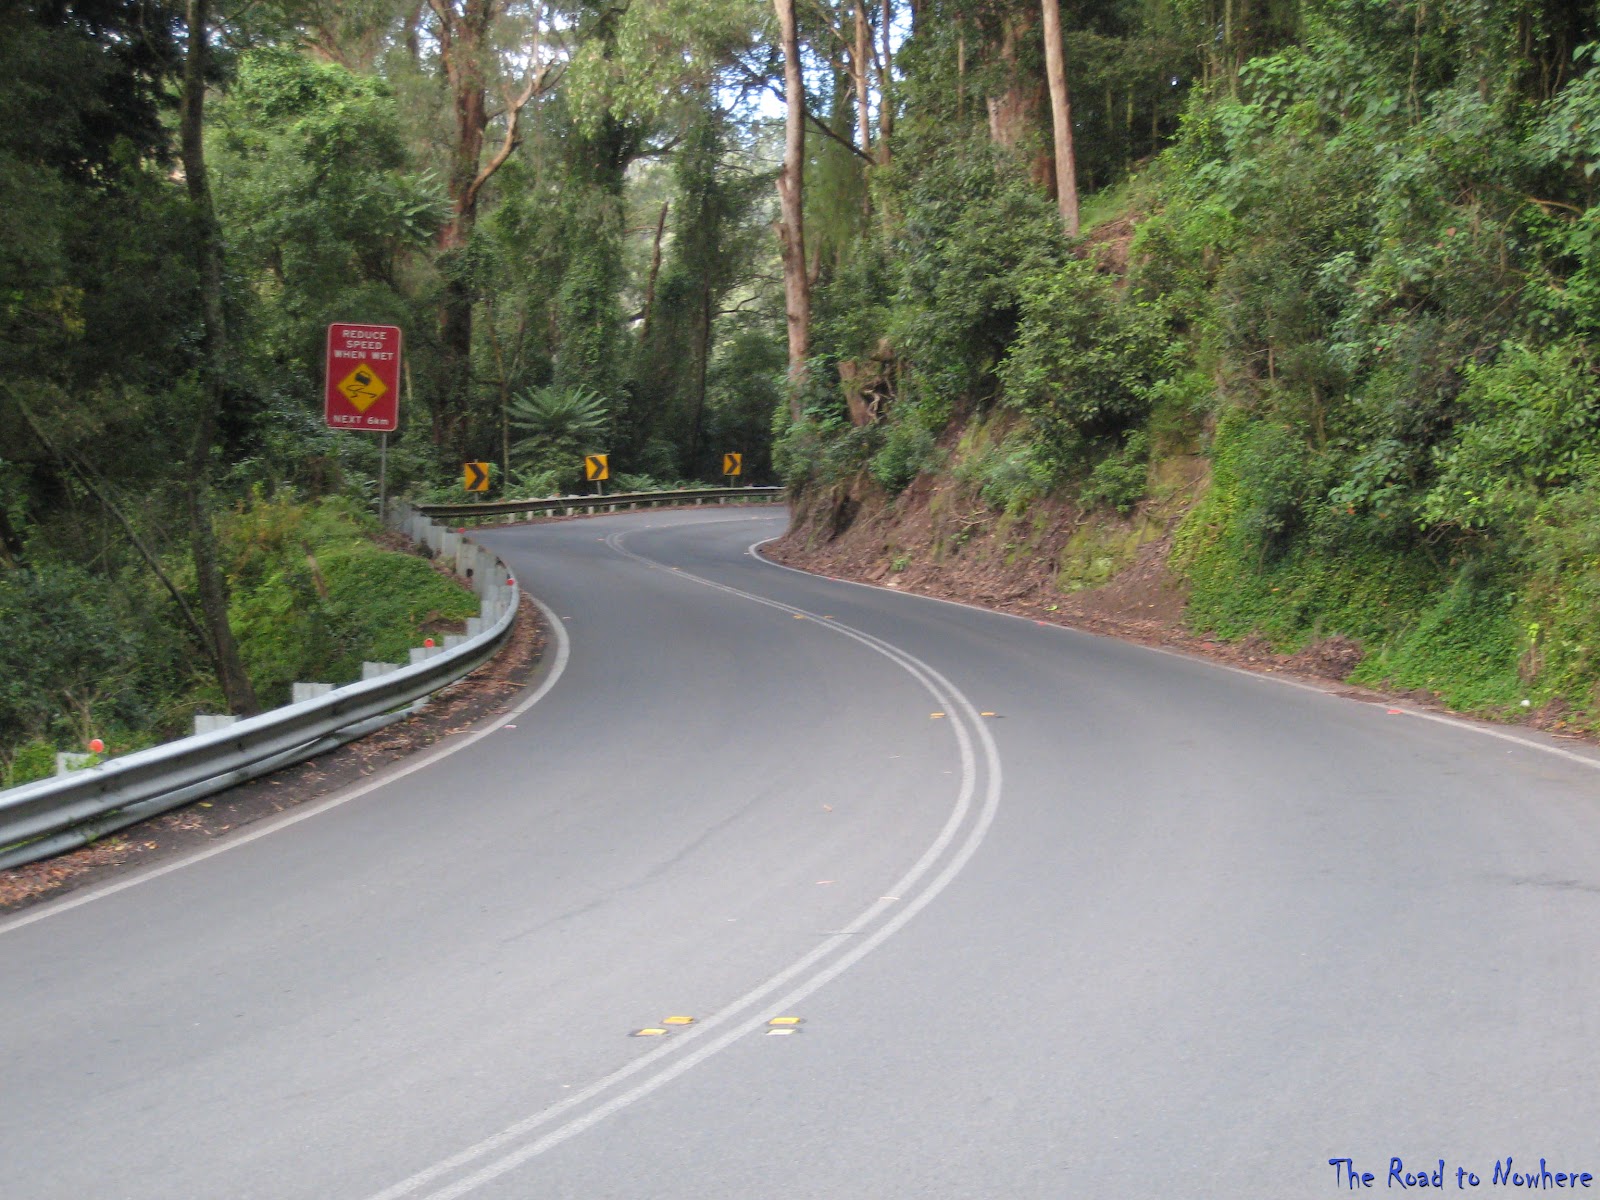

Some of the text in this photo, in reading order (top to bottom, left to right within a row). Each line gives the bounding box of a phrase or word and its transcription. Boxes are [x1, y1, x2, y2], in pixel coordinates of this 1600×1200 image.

[342, 329, 387, 340] REDUCE
[346, 340, 383, 350] SPEED
[334, 350, 394, 360] WHEN WET
[333, 415, 389, 425] NEXT 6km
